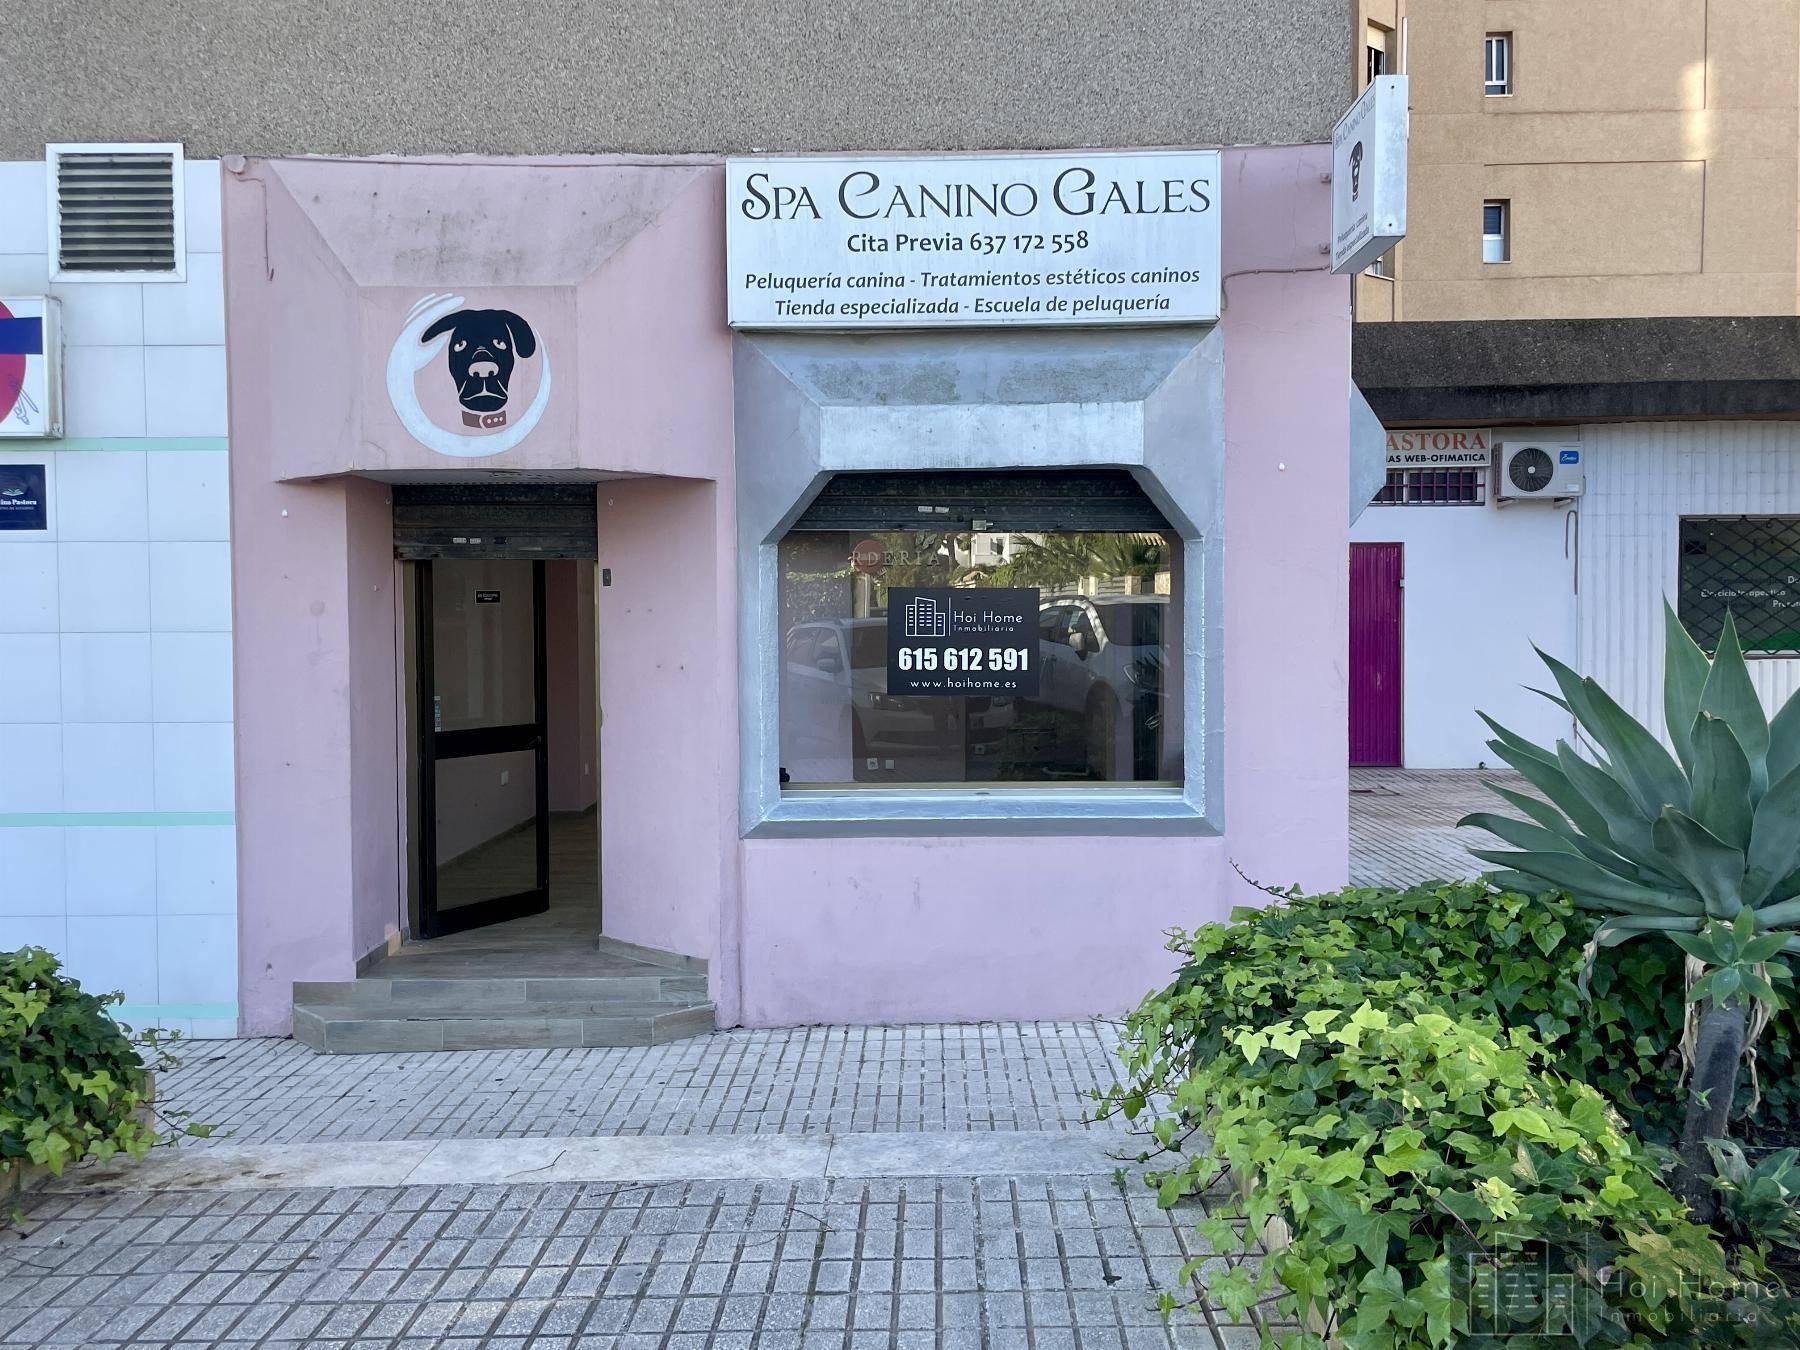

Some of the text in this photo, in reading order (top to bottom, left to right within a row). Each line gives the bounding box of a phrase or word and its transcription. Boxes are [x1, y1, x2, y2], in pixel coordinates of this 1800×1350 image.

[846, 230, 1089, 255] Cita Previa 637 172 558
[744, 272, 842, 293] Peluquería
[846, 271, 906, 289] canina
[920, 270, 1041, 288] Tratamientos
[1045, 269, 1126, 286] estéticos
[1130, 268, 1201, 285] caninos
[775, 299, 836, 316] Tienda
[840, 297, 960, 319] especializada
[974, 296, 1041, 314] Escuela
[1046, 296, 1068, 312] de
[1072, 294, 1171, 316] peluquería
[1405, 453, 1486, 463] WEB-OFIMATICA
[954, 611, 1023, 623] Hoi Home
[898, 648, 1028, 671] 615 612 591
[910, 677, 1017, 689] www.hoihome.es
